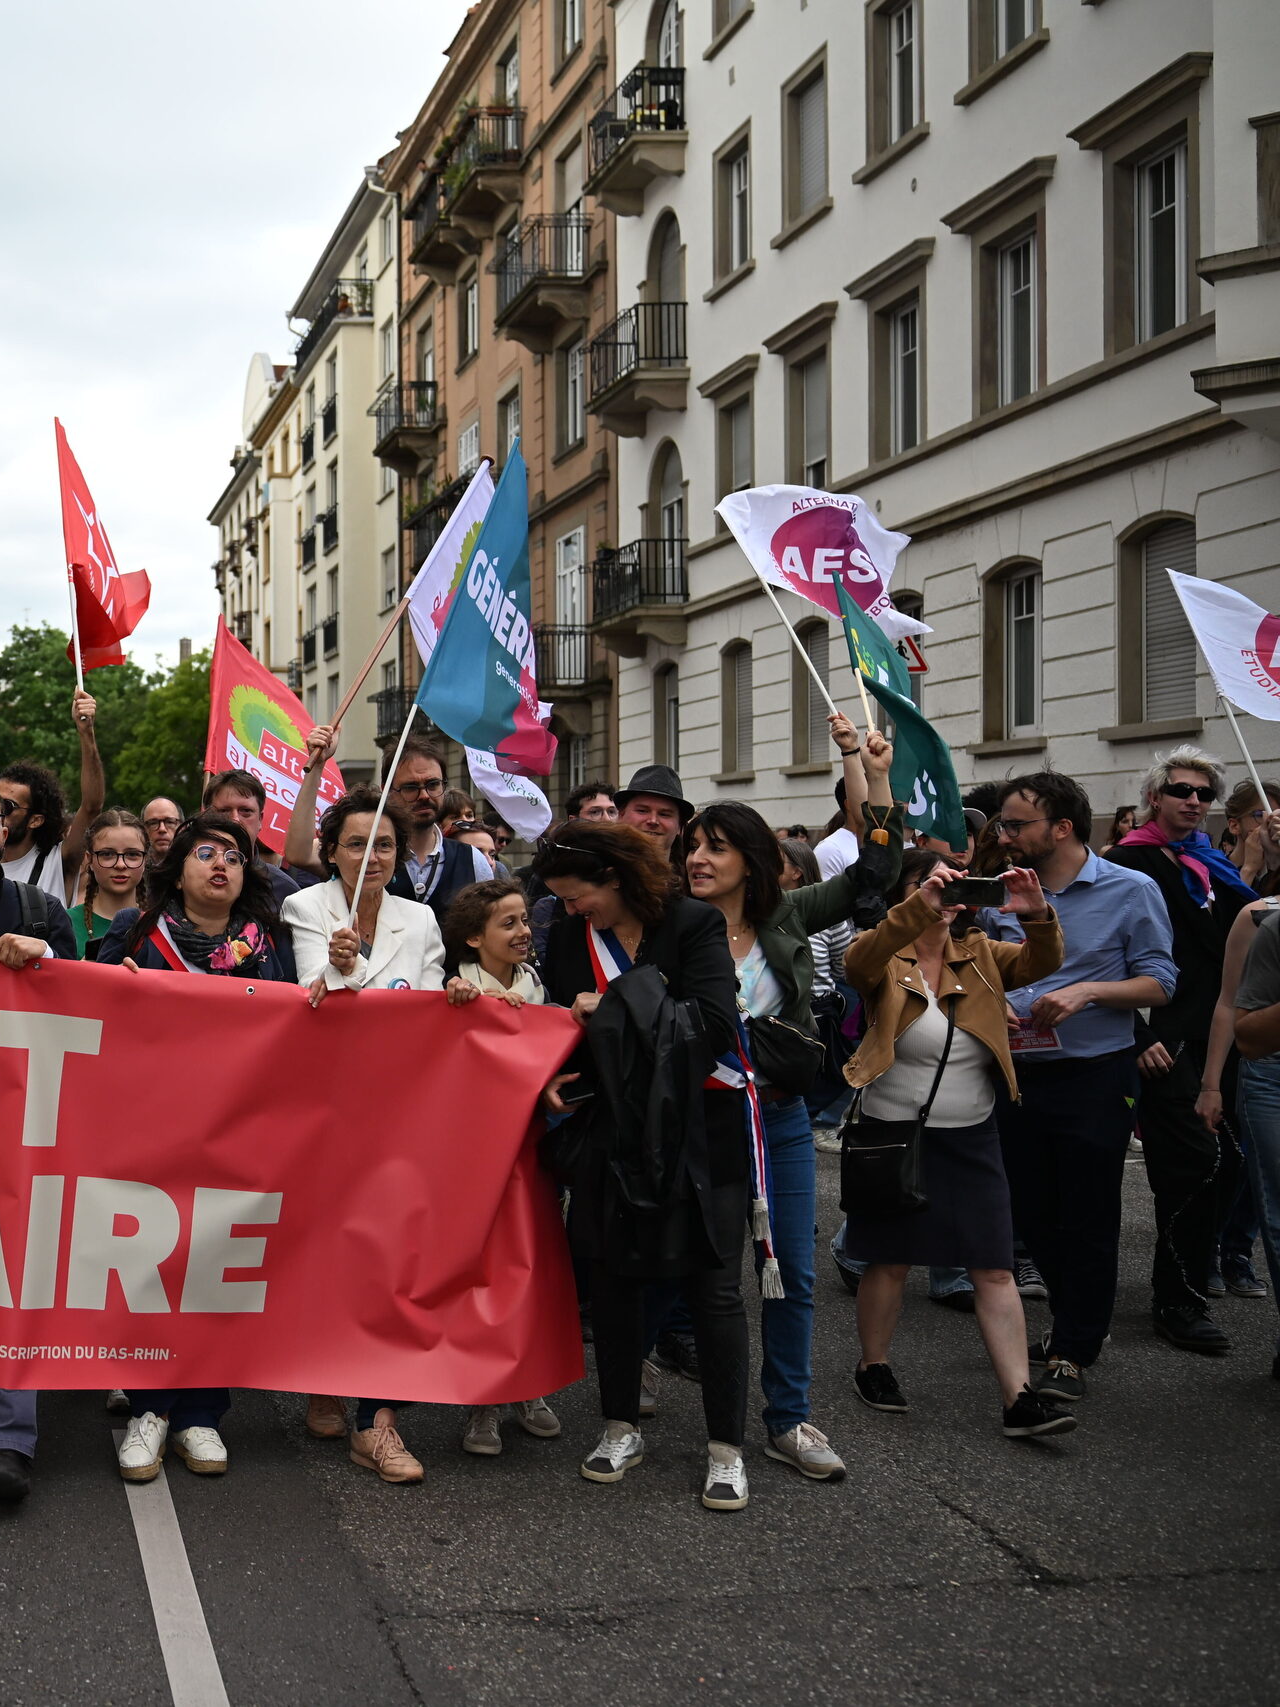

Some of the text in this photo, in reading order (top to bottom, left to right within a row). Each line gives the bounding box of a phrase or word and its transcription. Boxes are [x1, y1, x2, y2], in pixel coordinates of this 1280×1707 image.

[781, 546, 878, 584] AES
[74, 1345, 95, 1360] DU
[97, 1346, 170, 1361] BAS-RHIN
